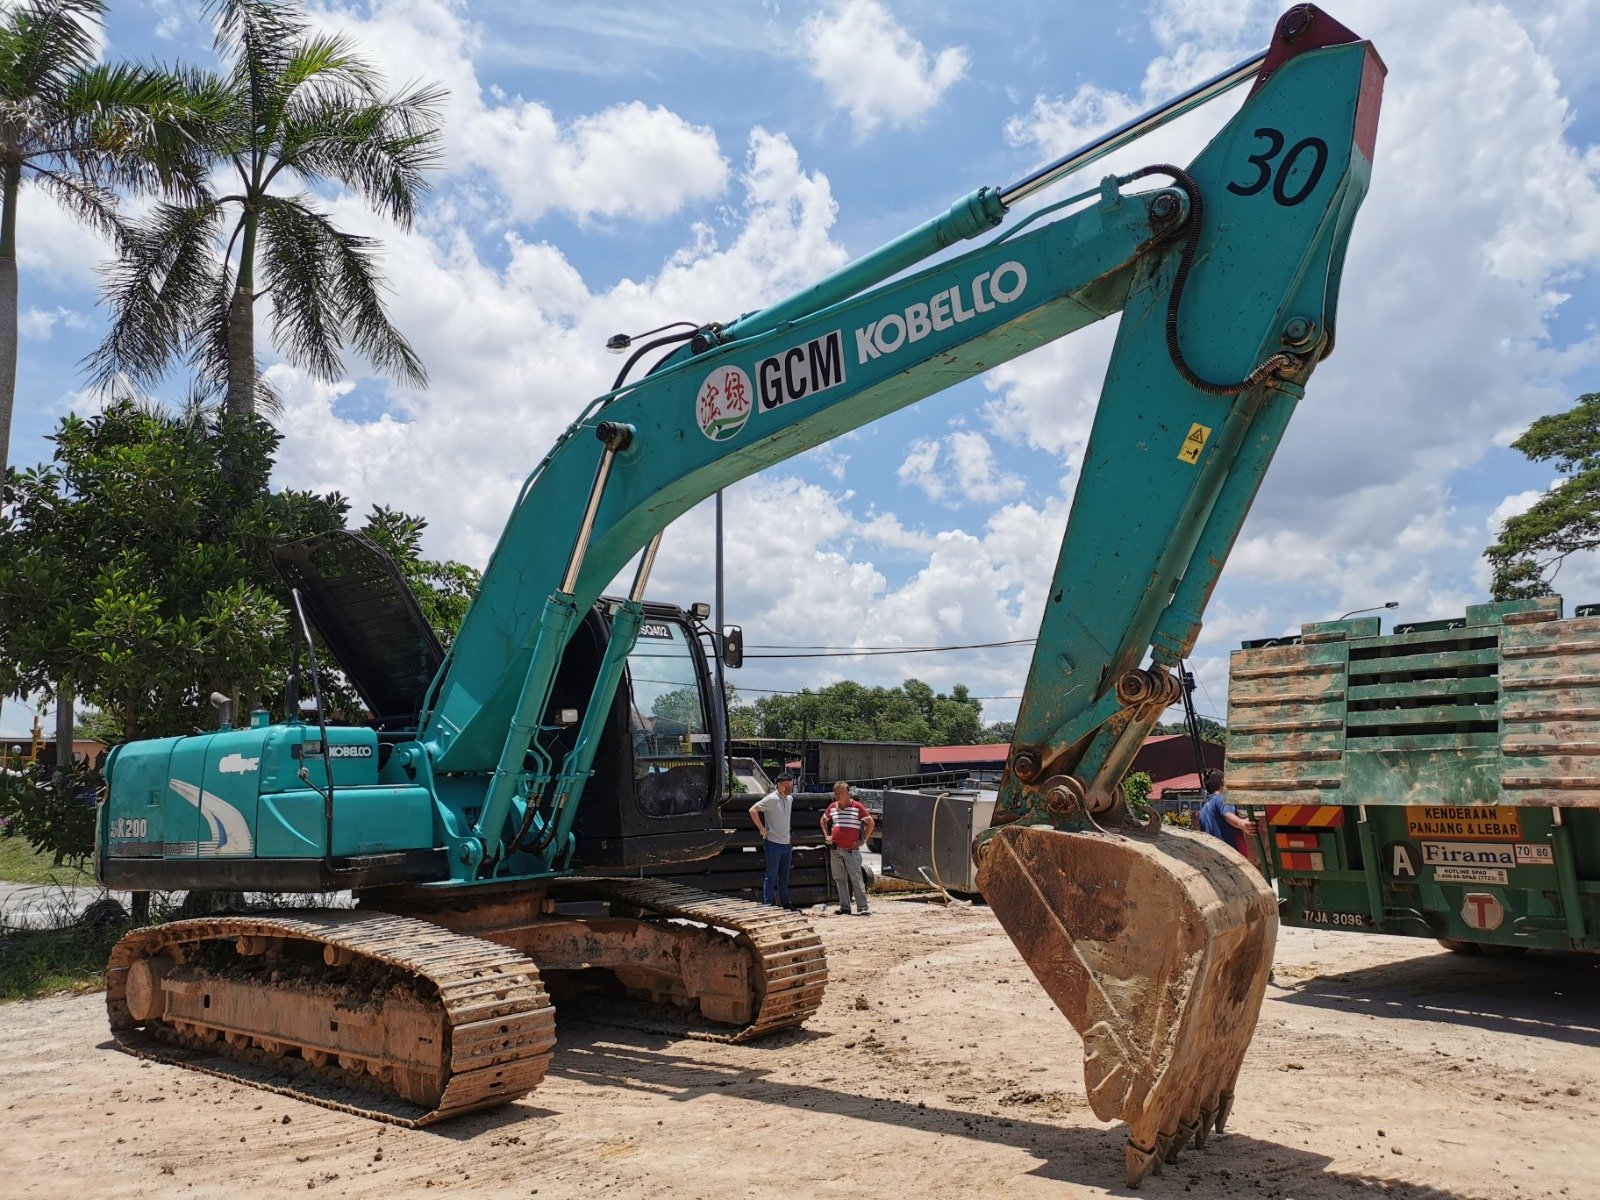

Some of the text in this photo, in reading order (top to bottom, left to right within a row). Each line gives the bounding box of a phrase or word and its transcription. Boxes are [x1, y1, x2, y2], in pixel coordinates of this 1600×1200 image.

[1226, 128, 1328, 207] 30
[855, 261, 1028, 364] KOBELCO
[759, 332, 842, 408] GCM
[639, 625, 668, 637] SQ402
[329, 746, 372, 757] KOBELCO
[1425, 807, 1498, 820] KENDERAAN
[110, 818, 147, 838] SK200
[1410, 822, 1519, 835] PANJANG & LEBAR
[1423, 844, 1514, 864] Firama
[1517, 846, 1530, 856] 70
[1536, 848, 1548, 857] 80
[1393, 845, 1416, 876] A
[1304, 910, 1362, 926] T/JA 3096
